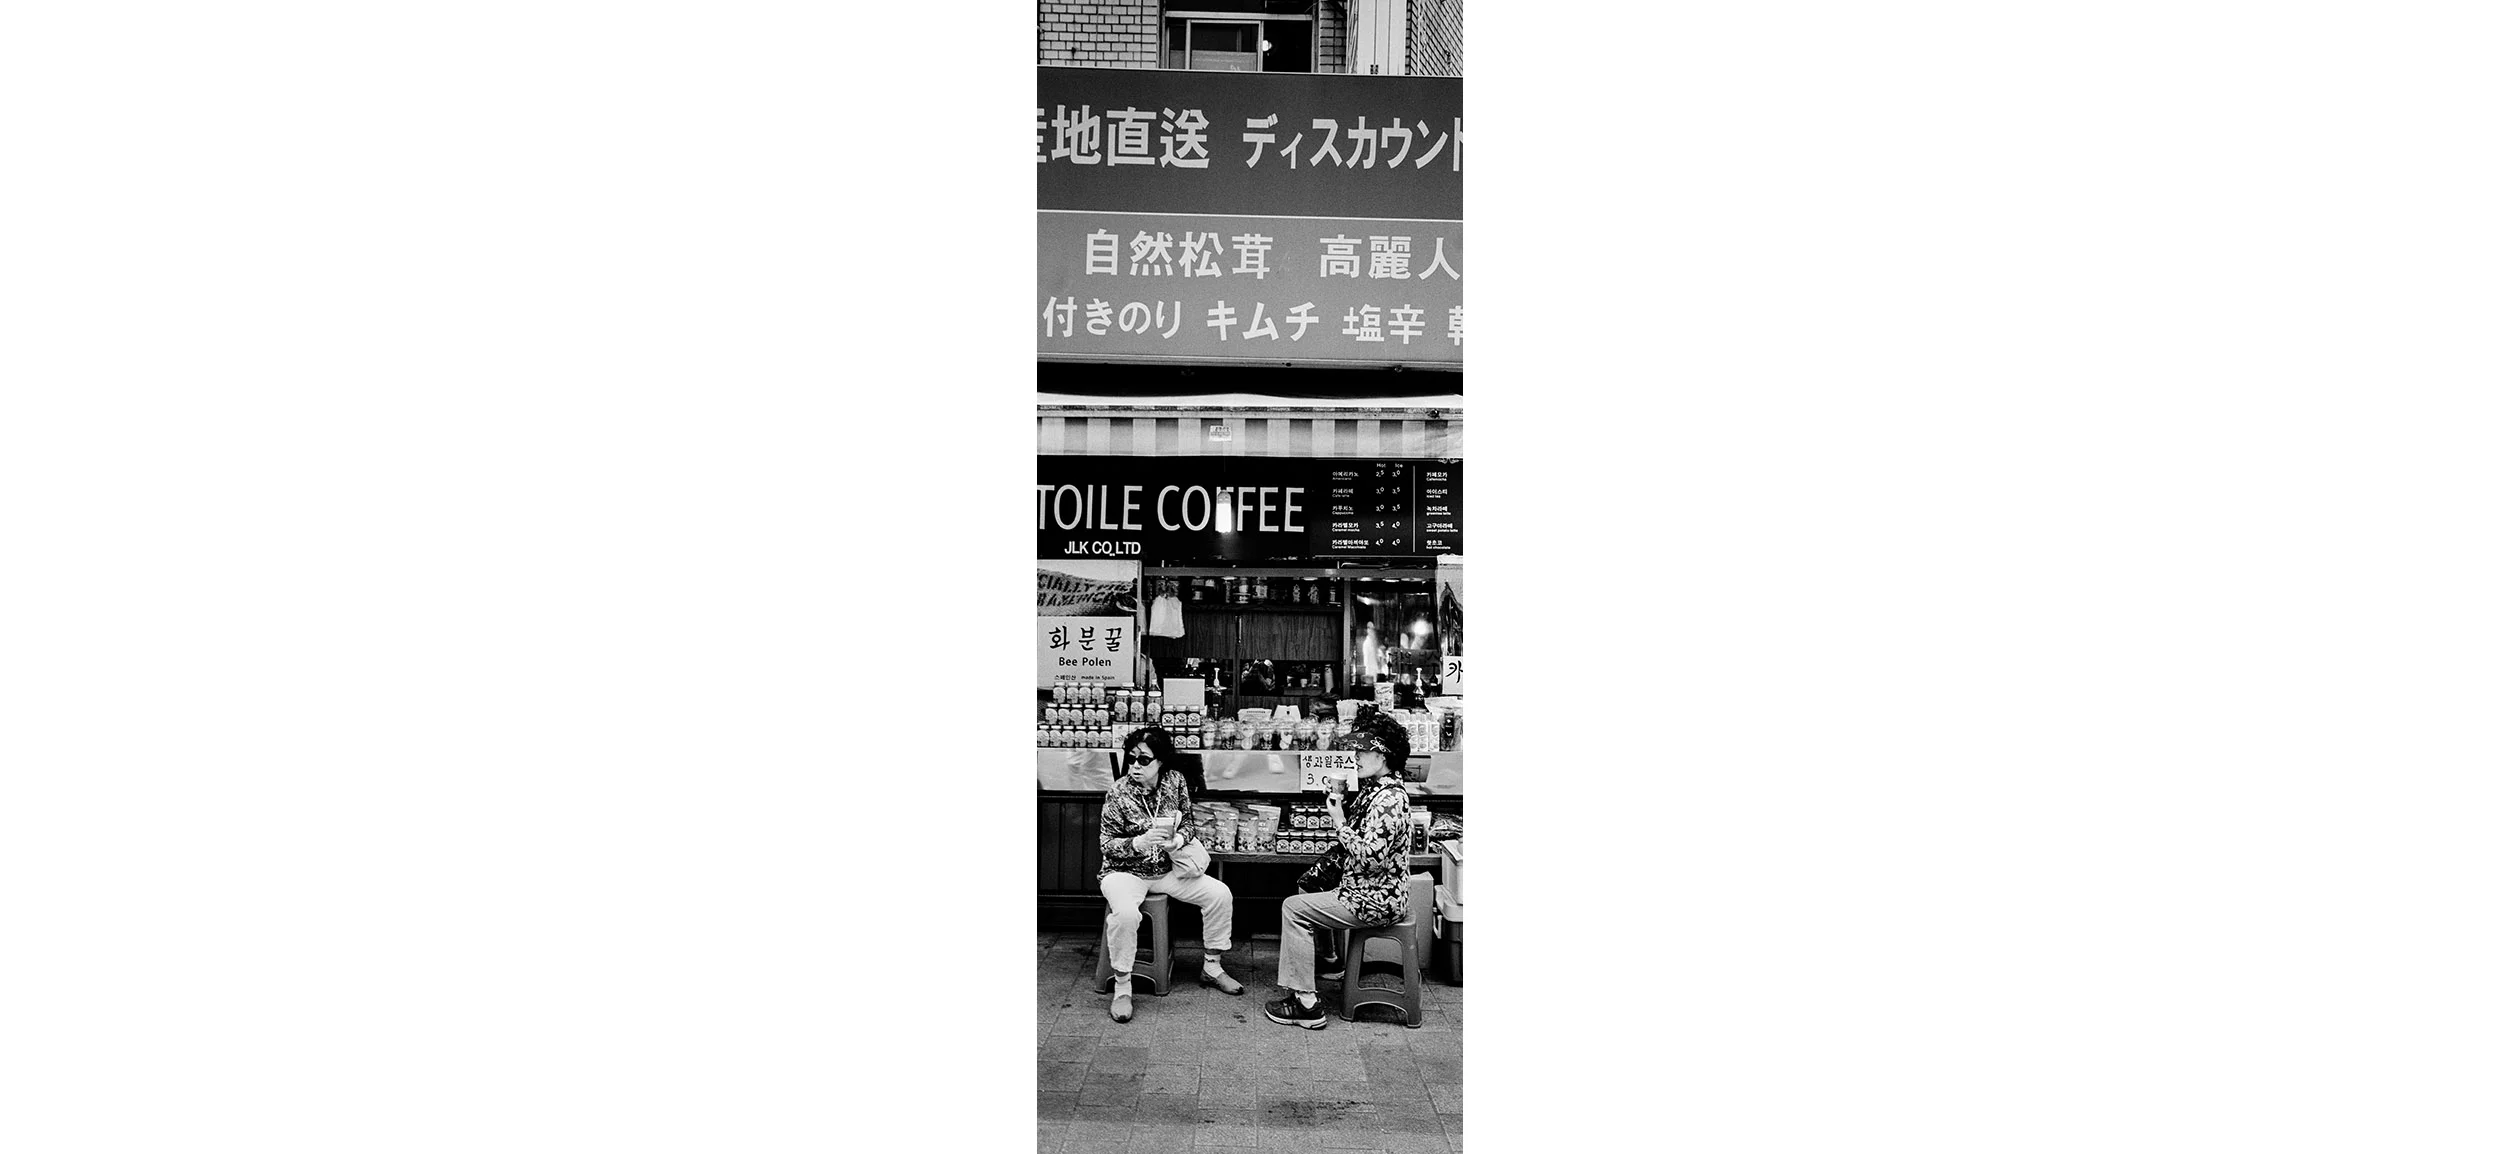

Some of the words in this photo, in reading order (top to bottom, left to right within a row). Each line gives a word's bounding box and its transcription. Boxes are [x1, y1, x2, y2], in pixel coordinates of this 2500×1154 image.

[1038, 105, 1210, 168] 地直送
[1086, 229, 1273, 279] 自然松茸
[1320, 234, 1460, 280] 高麗人
[1043, 297, 1180, 339] 付きのり
[1207, 301, 1319, 341] キムチ
[1342, 304, 1425, 344] 塩辛
[1038, 485, 1142, 530] TOILE
[1065, 541, 1088, 554] JLK
[1058, 656, 1078, 667] Bee
[1082, 656, 1112, 667] Polen
